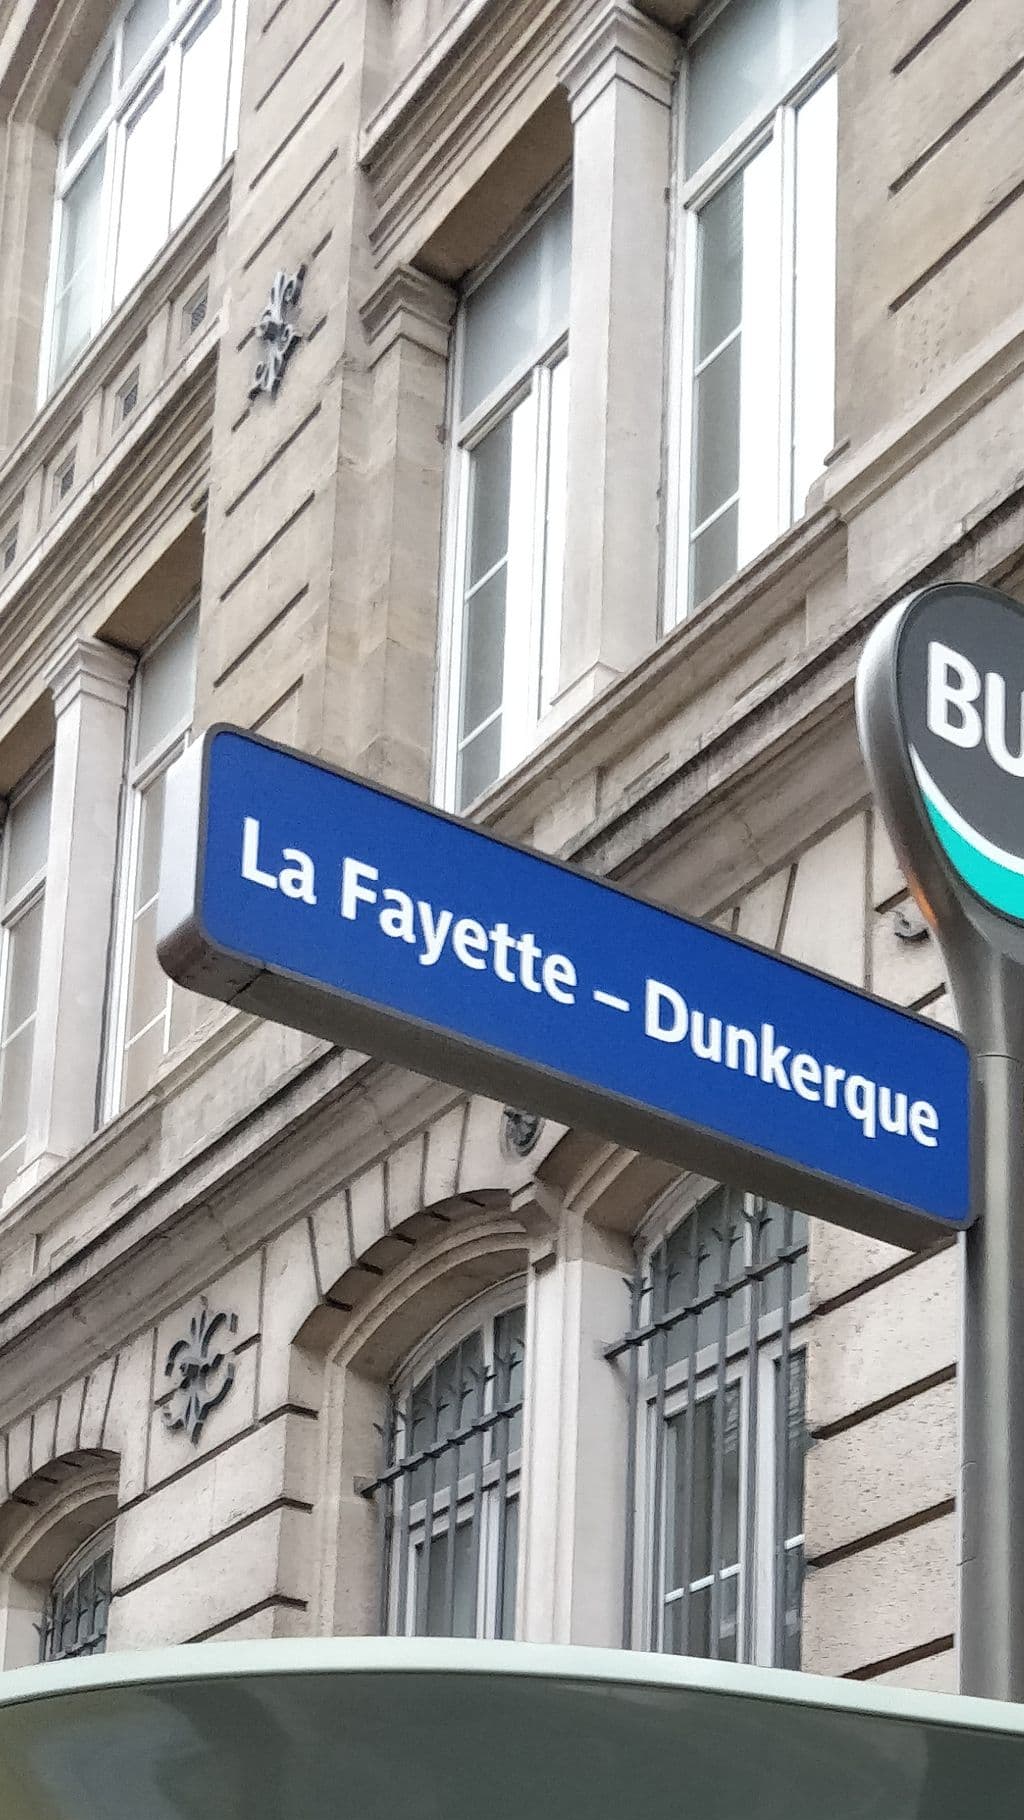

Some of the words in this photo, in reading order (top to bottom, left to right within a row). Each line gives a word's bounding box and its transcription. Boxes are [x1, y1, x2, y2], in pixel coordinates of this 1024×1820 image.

[240, 816, 317, 905] La
[340, 856, 578, 1005] Fayette
[644, 978, 939, 1147] Dunkerque
